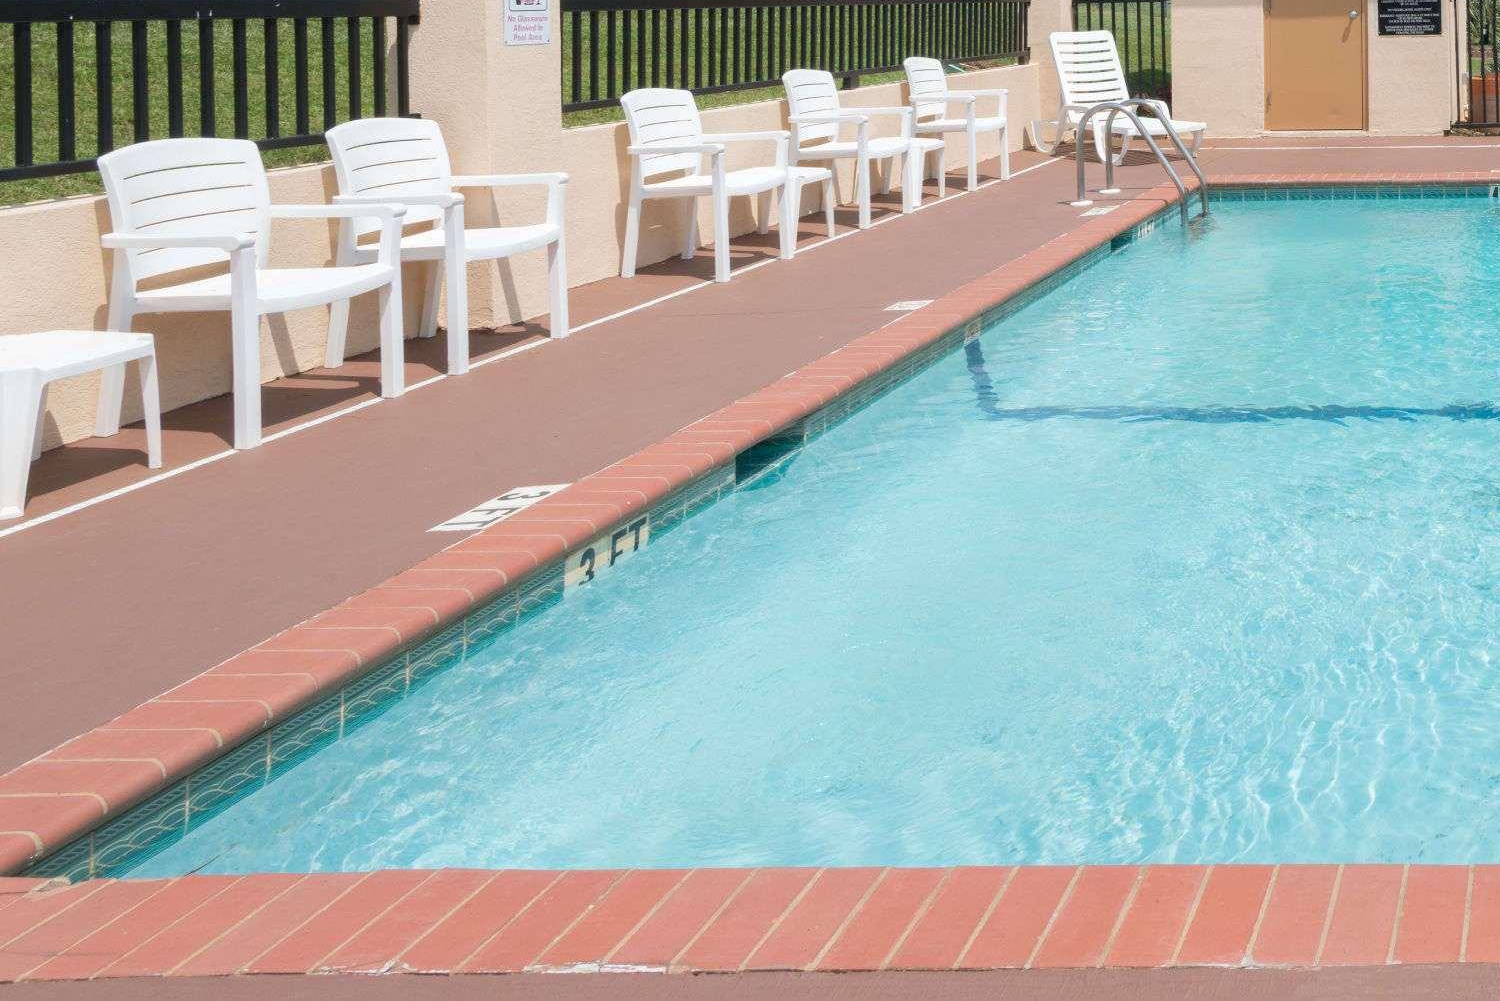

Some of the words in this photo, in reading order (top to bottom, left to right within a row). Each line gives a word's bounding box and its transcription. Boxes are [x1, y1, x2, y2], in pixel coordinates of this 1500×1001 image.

[507, 14, 517, 22] No
[513, 32, 527, 40] Pool
[441, 507, 520, 528] FT
[578, 547, 595, 587] 3
[608, 514, 647, 568] FT
